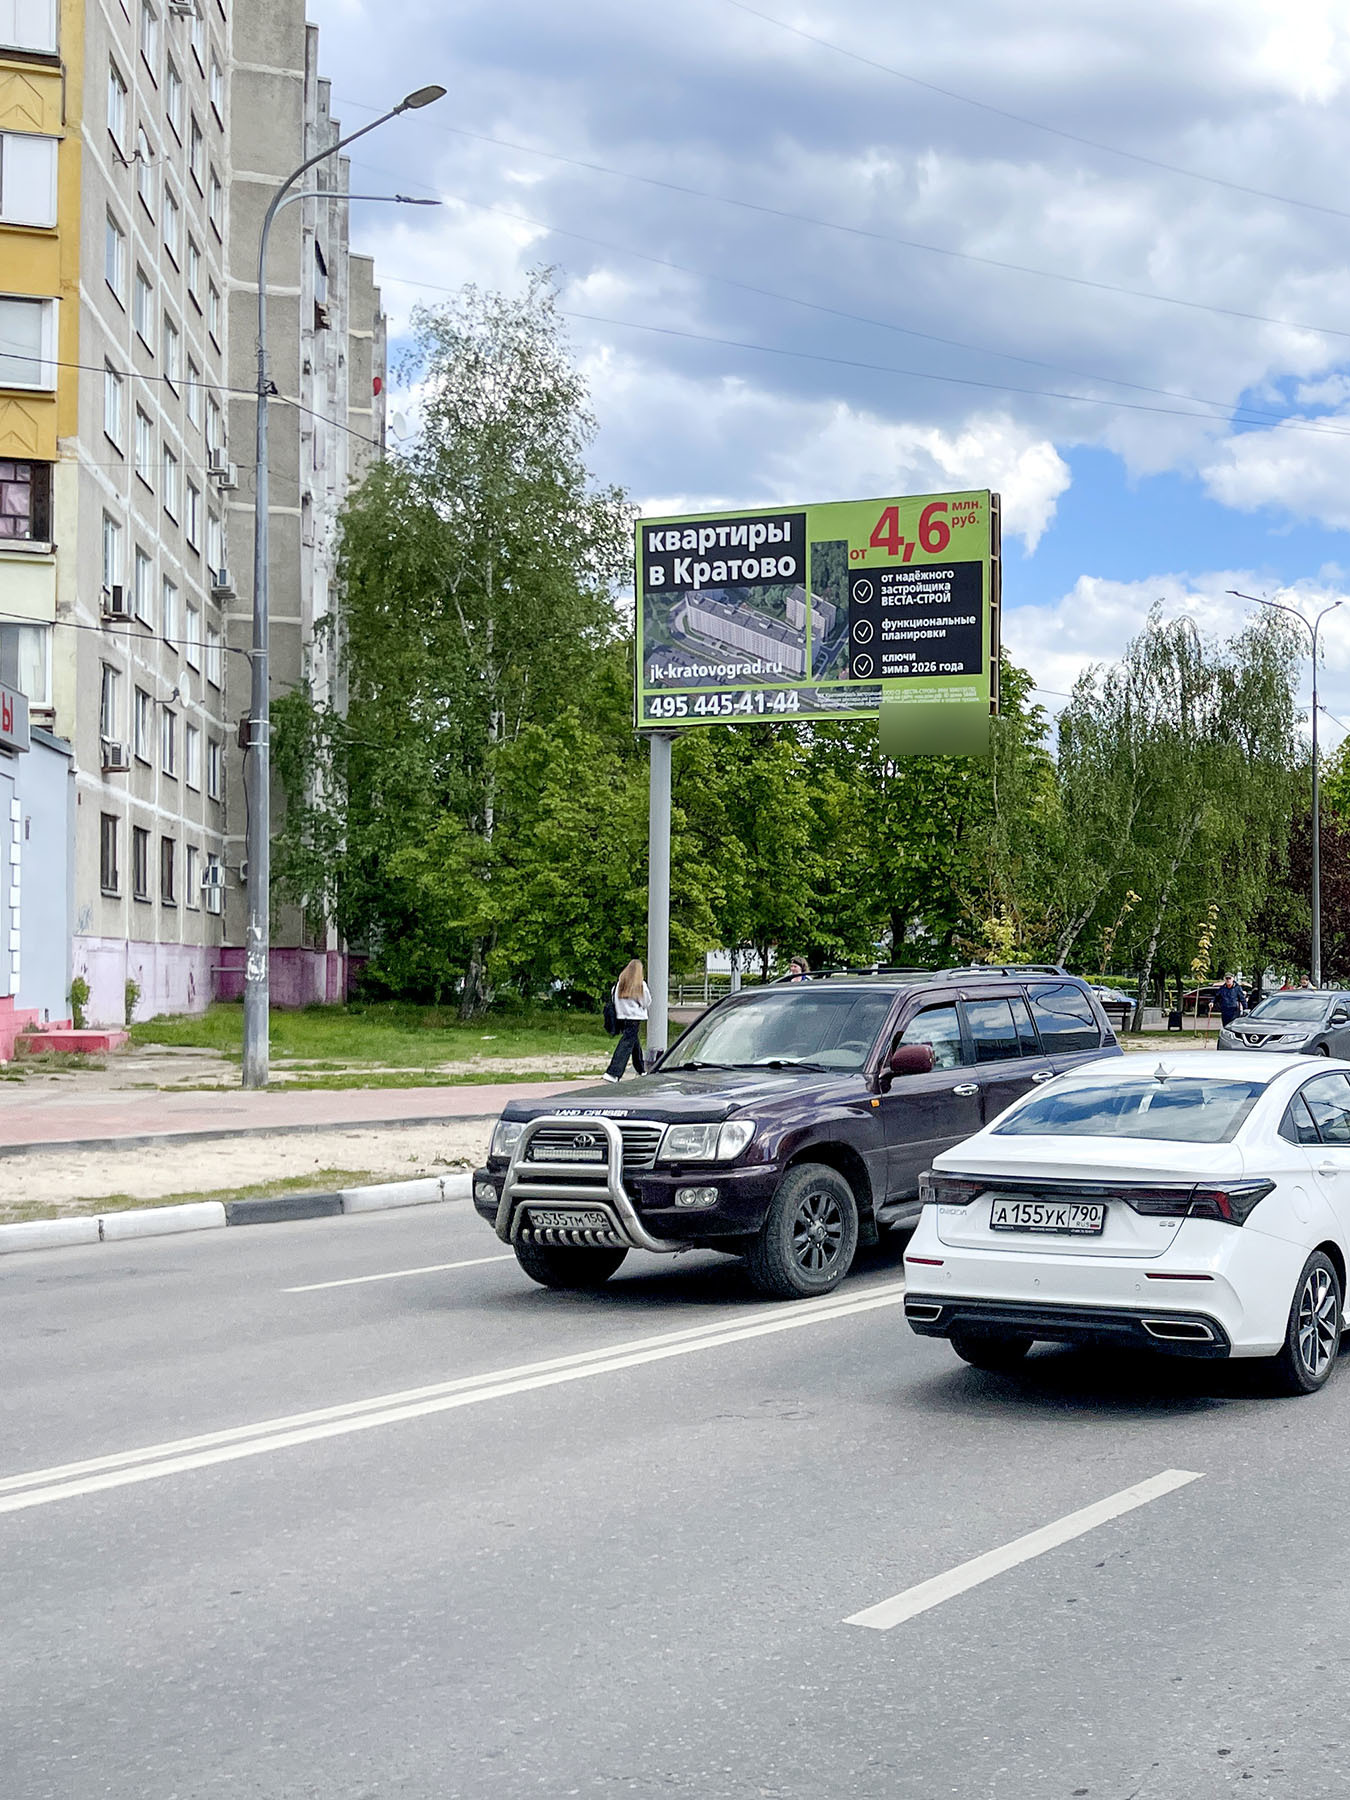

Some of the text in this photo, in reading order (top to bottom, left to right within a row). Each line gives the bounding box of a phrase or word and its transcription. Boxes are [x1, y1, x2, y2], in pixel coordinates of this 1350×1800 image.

[952, 500, 983, 511] млн.
[951, 511, 980, 529] руб.
[648, 521, 791, 556] квартиры
[849, 502, 951, 562] от 4,6
[648, 555, 797, 590] в Кратово
[880, 569, 955, 583] от надёжного
[880, 581, 951, 595] застройщика
[881, 591, 951, 607] ВЕСТА-СТРОЙ
[881, 615, 977, 632] функциональные
[881, 629, 947, 642] планировки
[881, 652, 916, 663] ключи
[649, 659, 783, 683] jk-kratovograd.ru
[881, 661, 964, 674] зима 2026 года
[649, 696, 688, 718] 495
[693, 691, 801, 716] 445-41-44
[555, 1109, 629, 1117] LAND CRUISER
[997, 1203, 1099, 1226] А155УК 790
